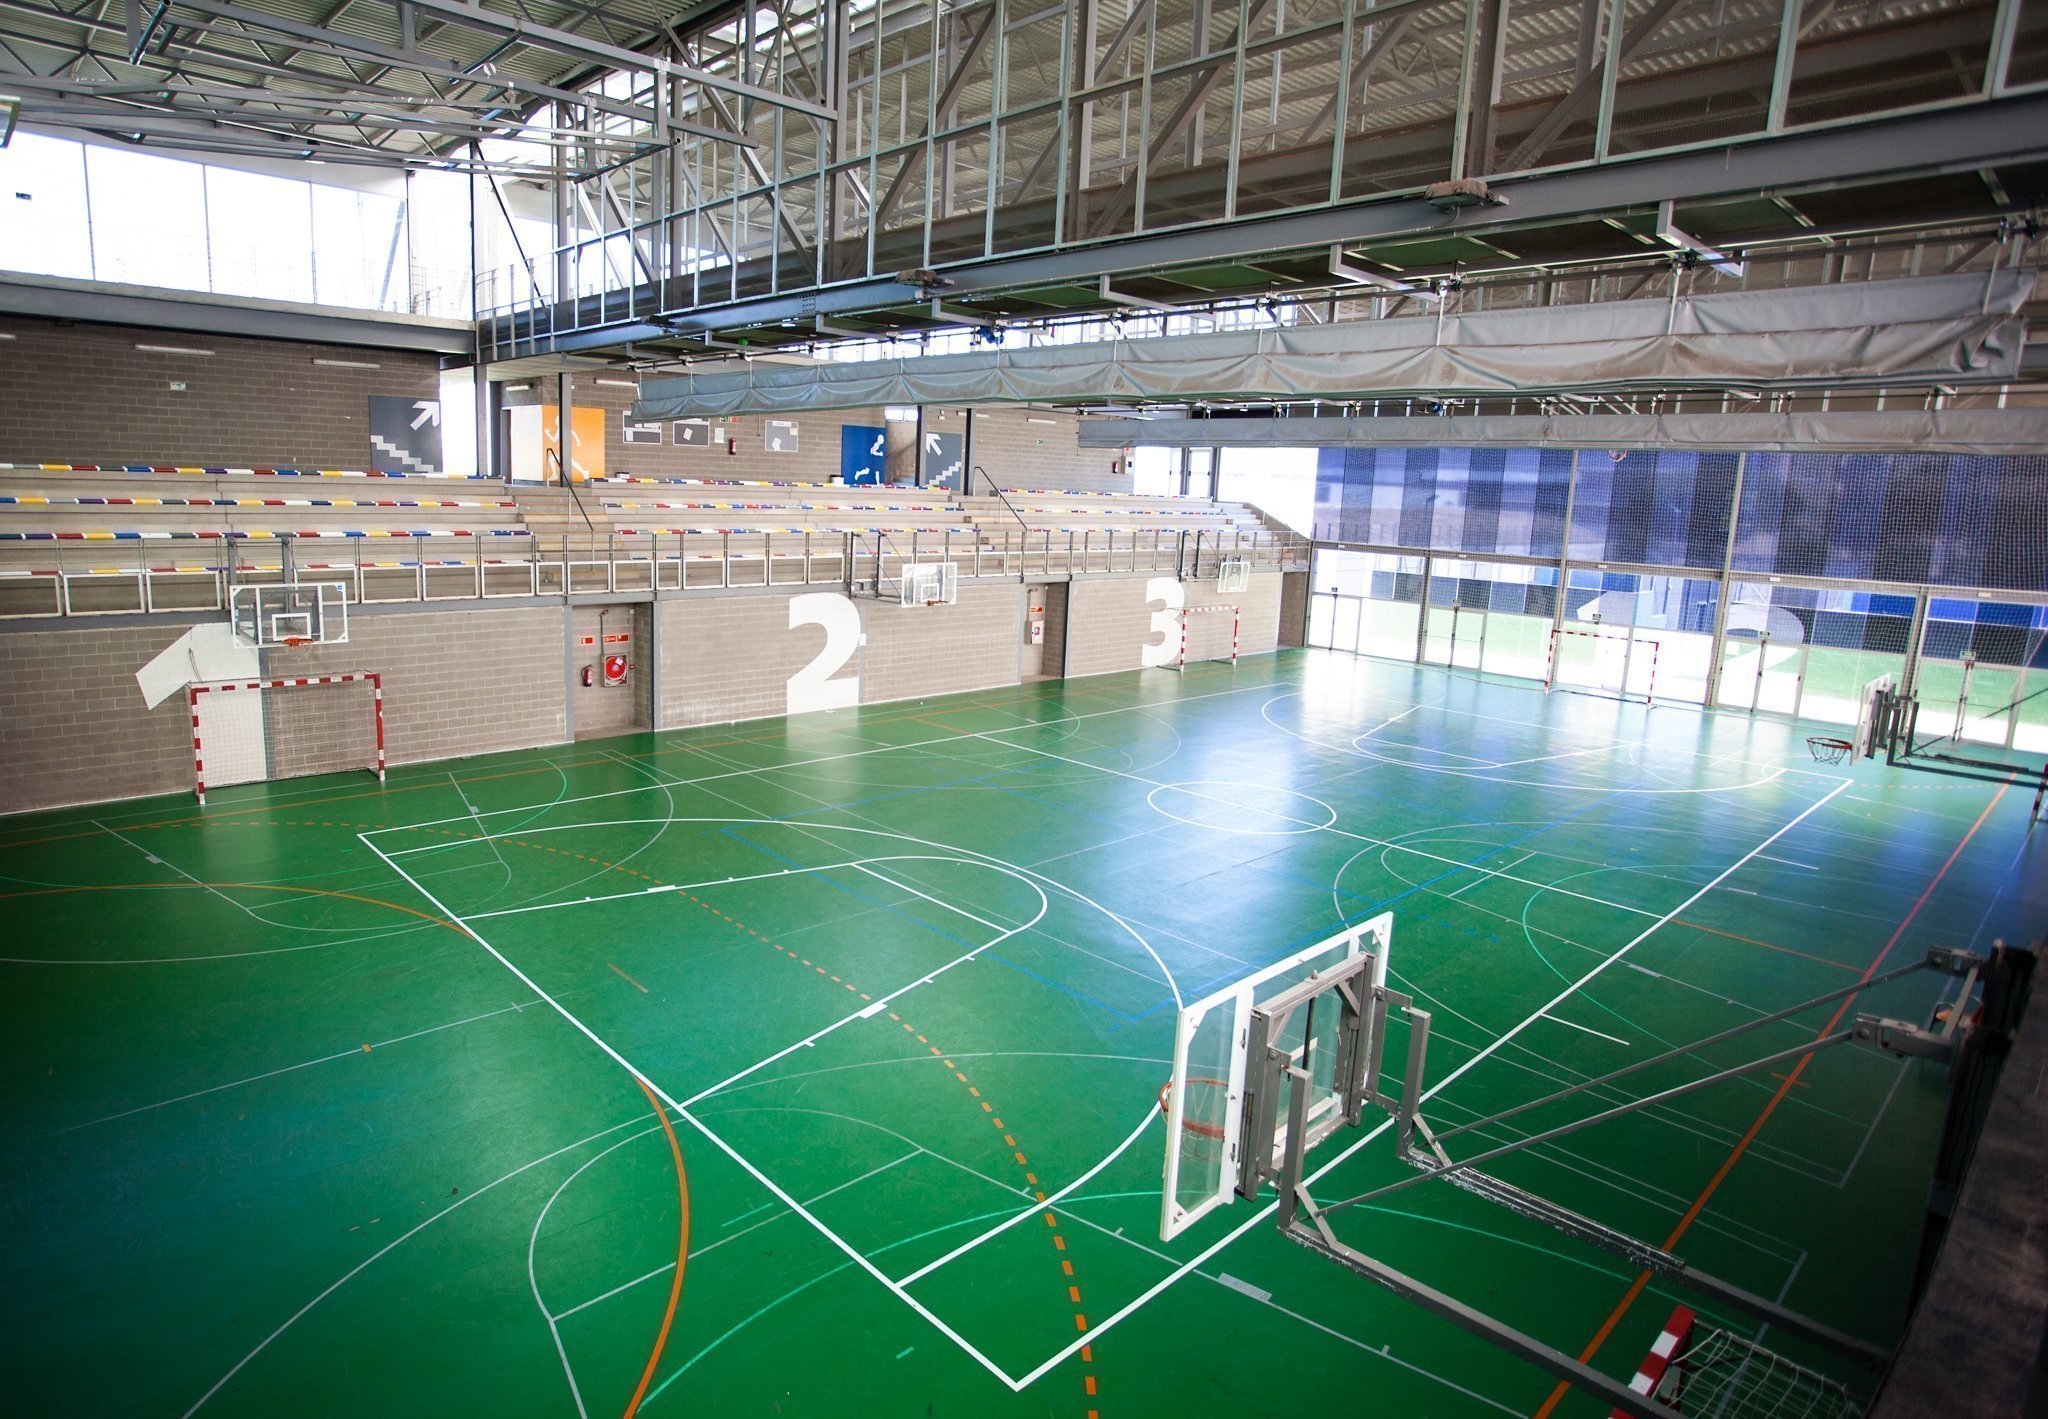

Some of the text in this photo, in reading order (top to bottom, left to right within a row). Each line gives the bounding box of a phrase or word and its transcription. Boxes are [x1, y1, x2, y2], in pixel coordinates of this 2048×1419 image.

[786, 591, 861, 715] 2
[1142, 576, 1184, 667] 3
[135, 621, 269, 785] 1
